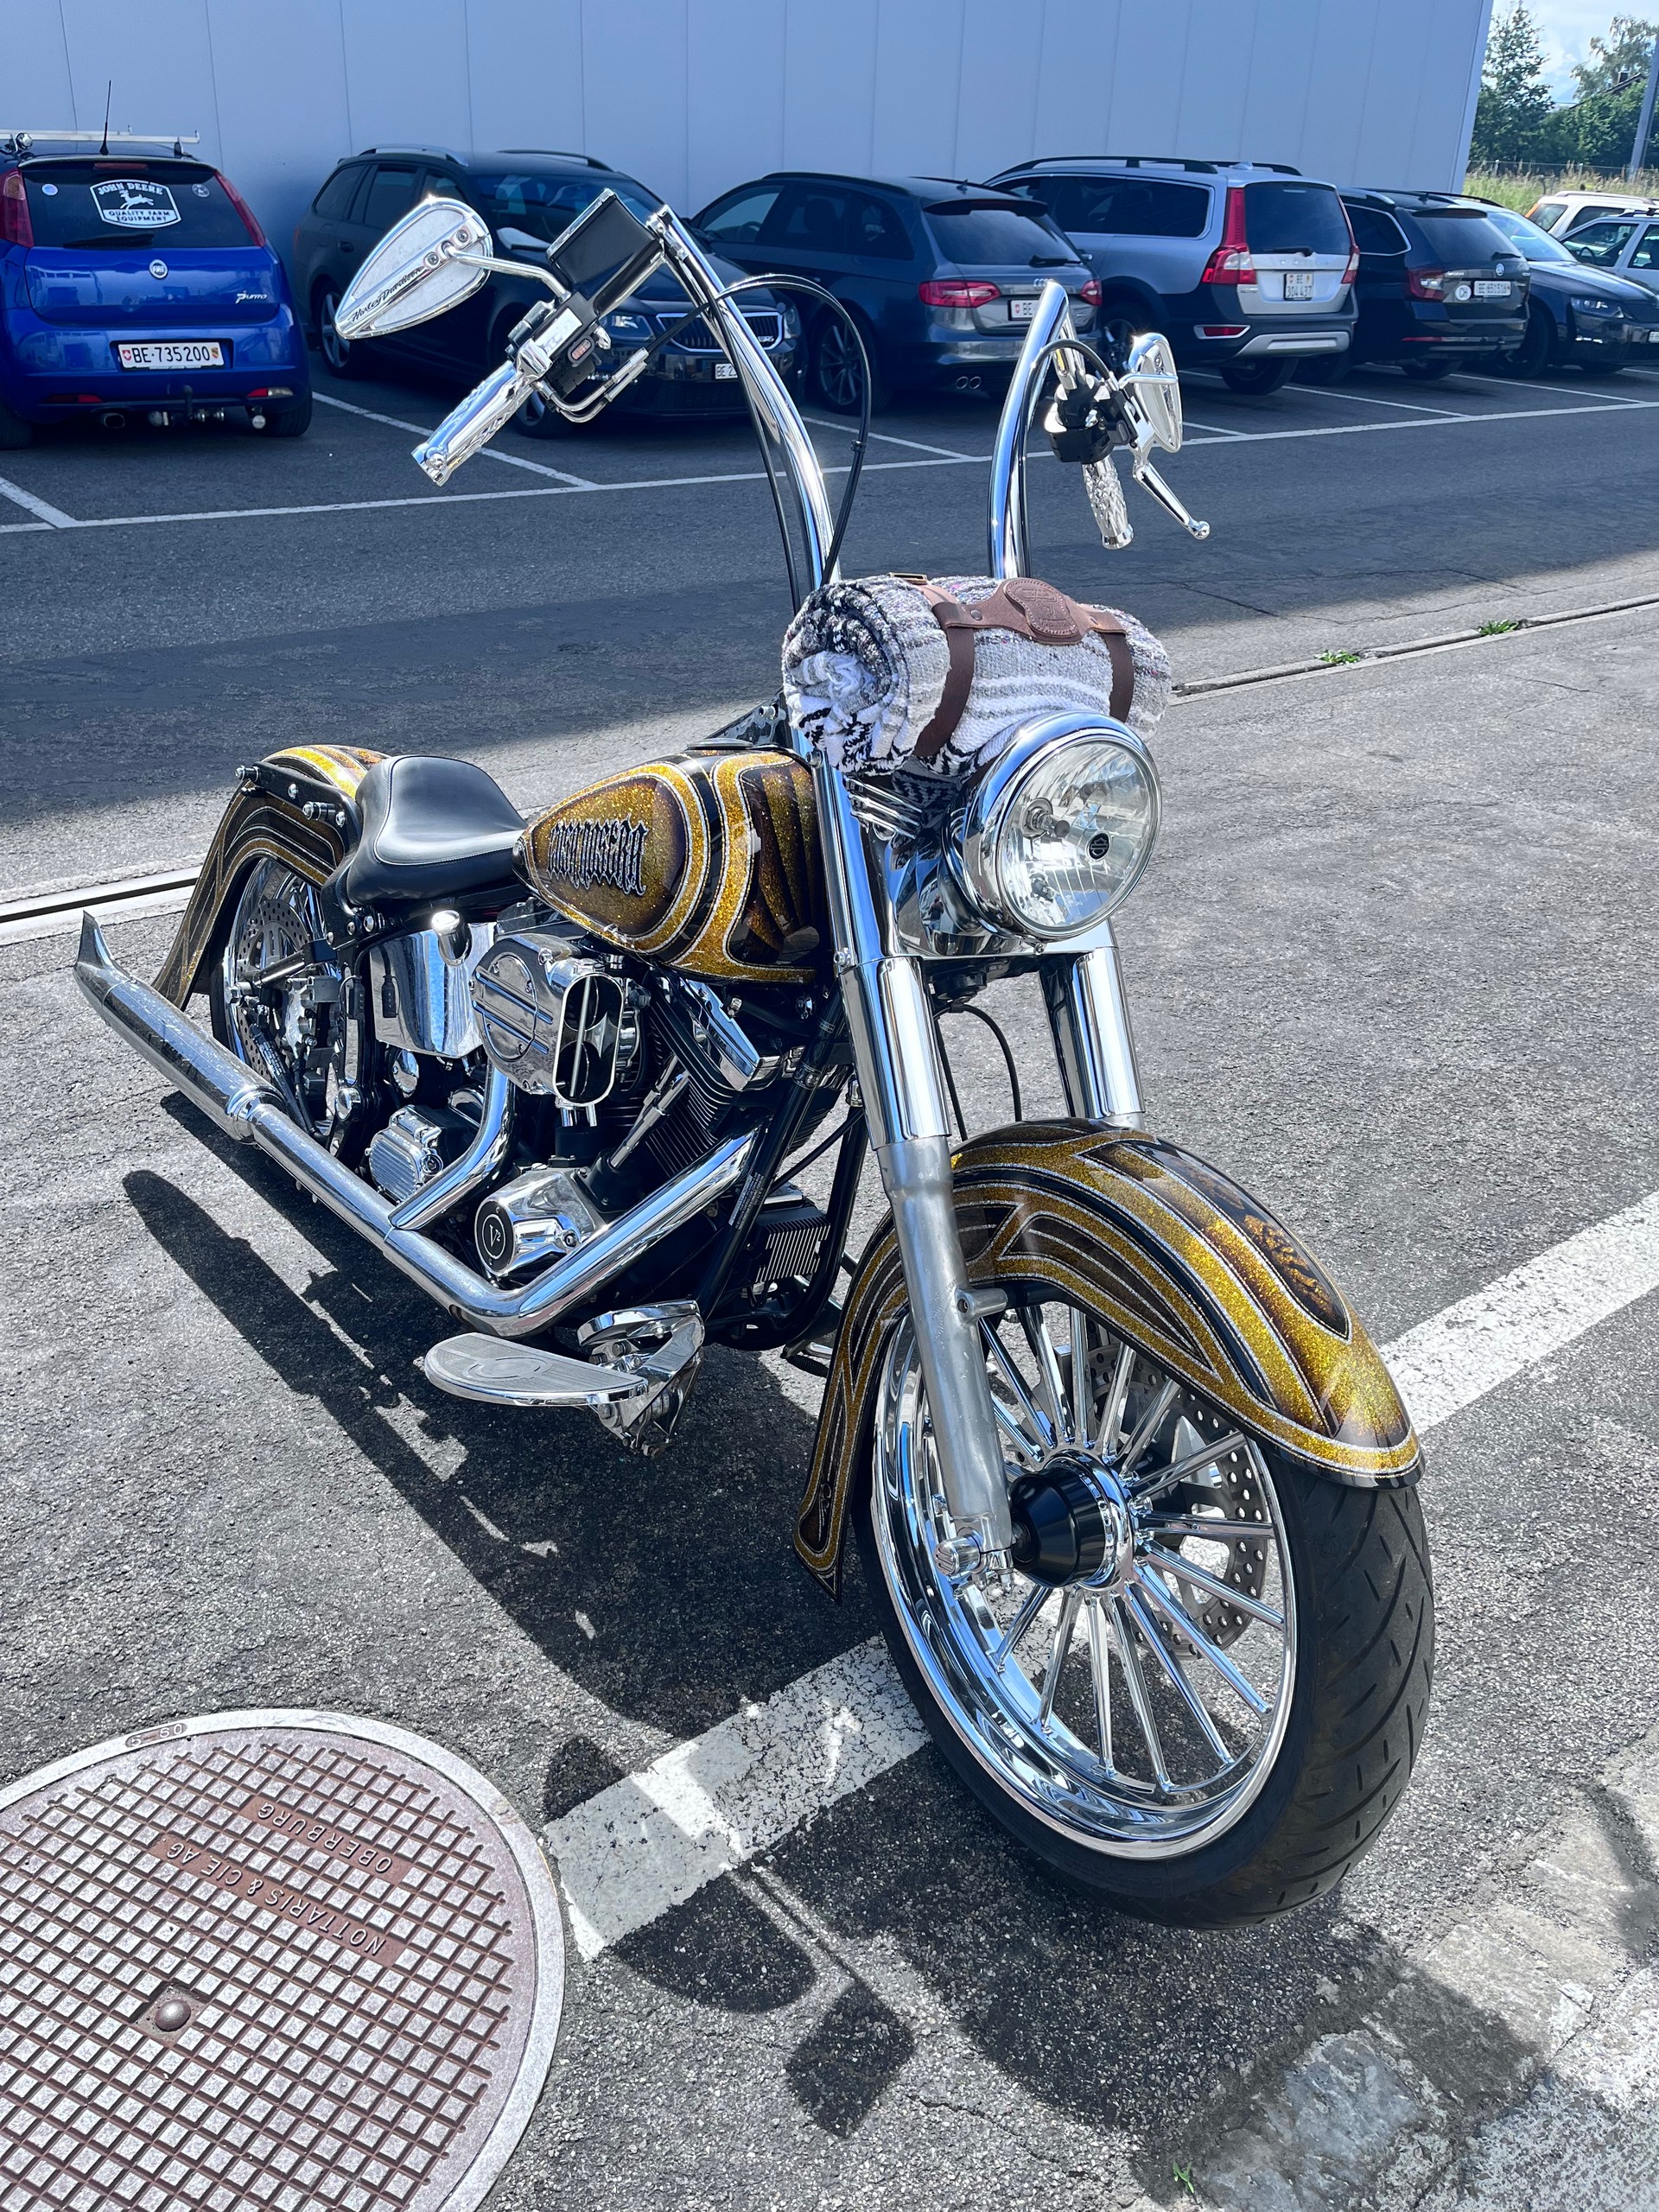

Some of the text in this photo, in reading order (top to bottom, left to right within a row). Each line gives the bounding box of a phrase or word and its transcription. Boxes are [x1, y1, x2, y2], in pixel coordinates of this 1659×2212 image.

[98, 182, 163, 195] JOHN DEERE
[257, 1802, 392, 1873] OBERBURG
[247, 1878, 263, 1896] &
[264, 1888, 387, 1955] NOTTARIS
